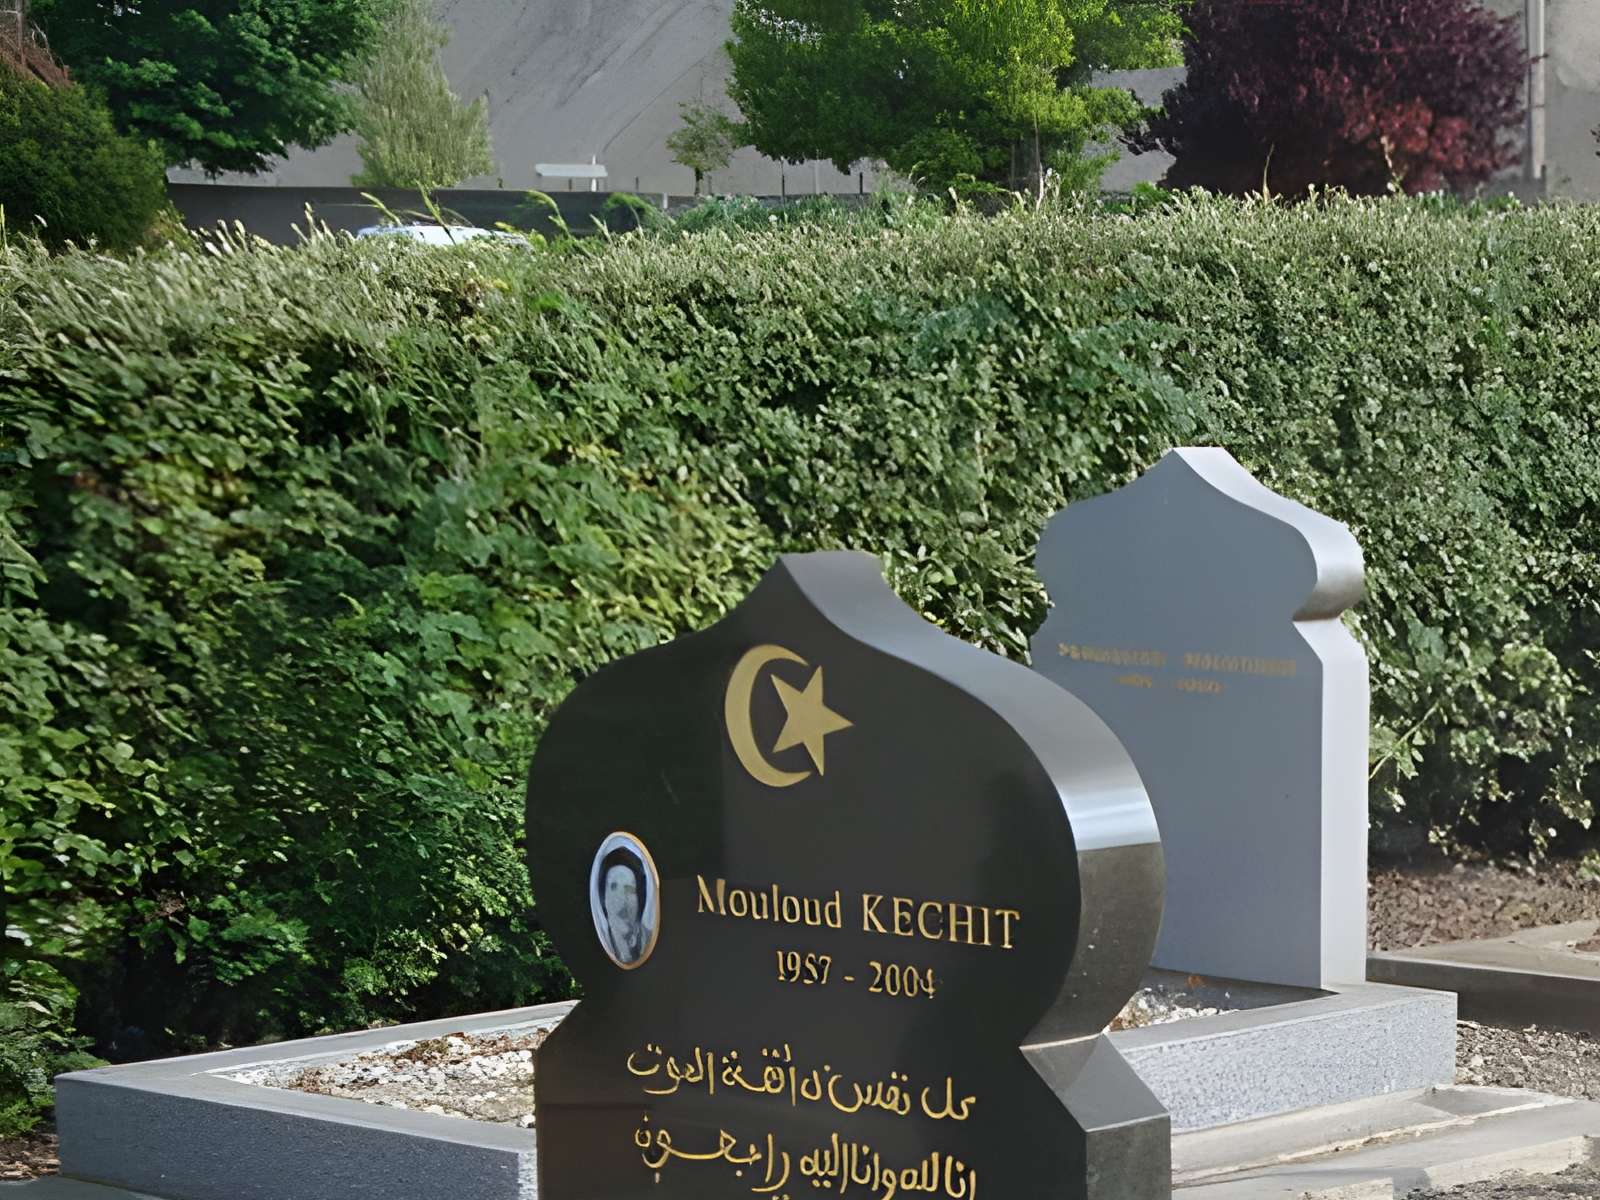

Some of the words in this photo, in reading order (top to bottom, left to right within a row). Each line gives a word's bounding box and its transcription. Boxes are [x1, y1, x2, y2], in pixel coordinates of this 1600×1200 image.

[696, 874, 842, 929] Mouloud
[862, 893, 1021, 949] KECHIT
[868, 960, 937, 999] 2004
